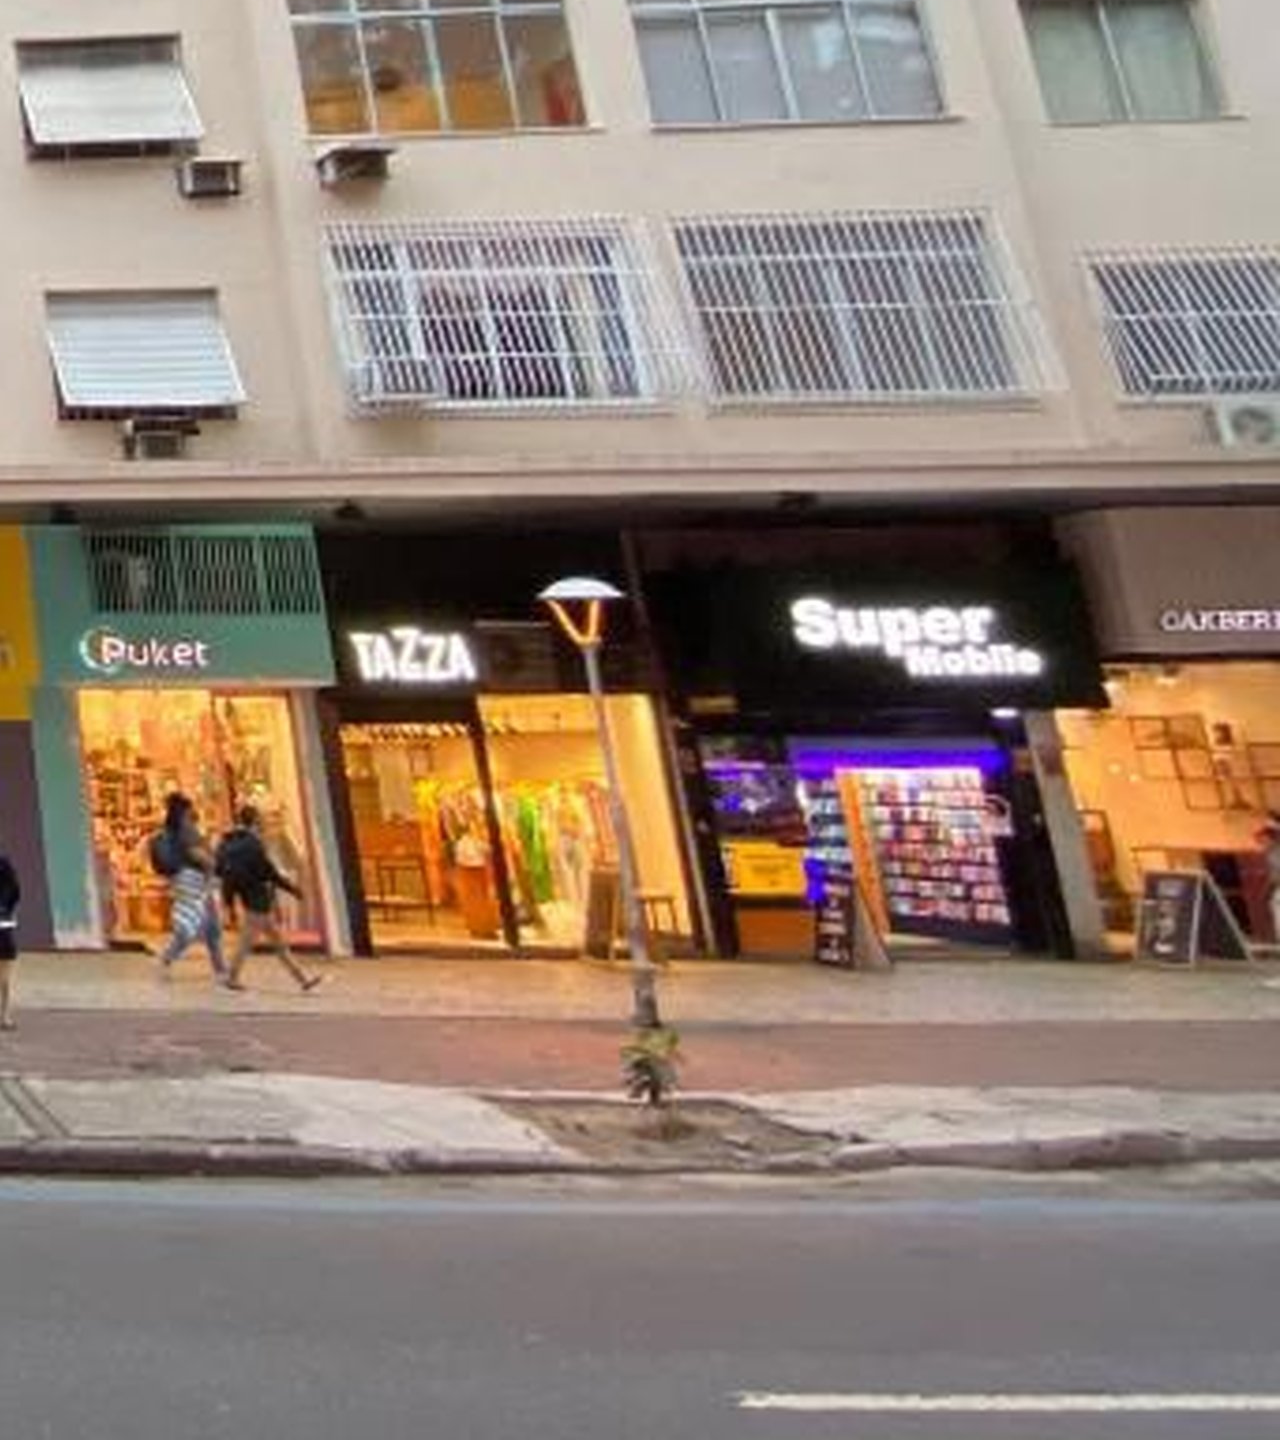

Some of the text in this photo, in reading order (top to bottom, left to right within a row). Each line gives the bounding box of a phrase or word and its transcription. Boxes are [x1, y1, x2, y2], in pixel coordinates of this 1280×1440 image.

[791, 598, 994, 658] Super
[101, 634, 209, 668] Puket
[348, 627, 477, 681] TAZZA
[904, 644, 1043, 676] Mobile
